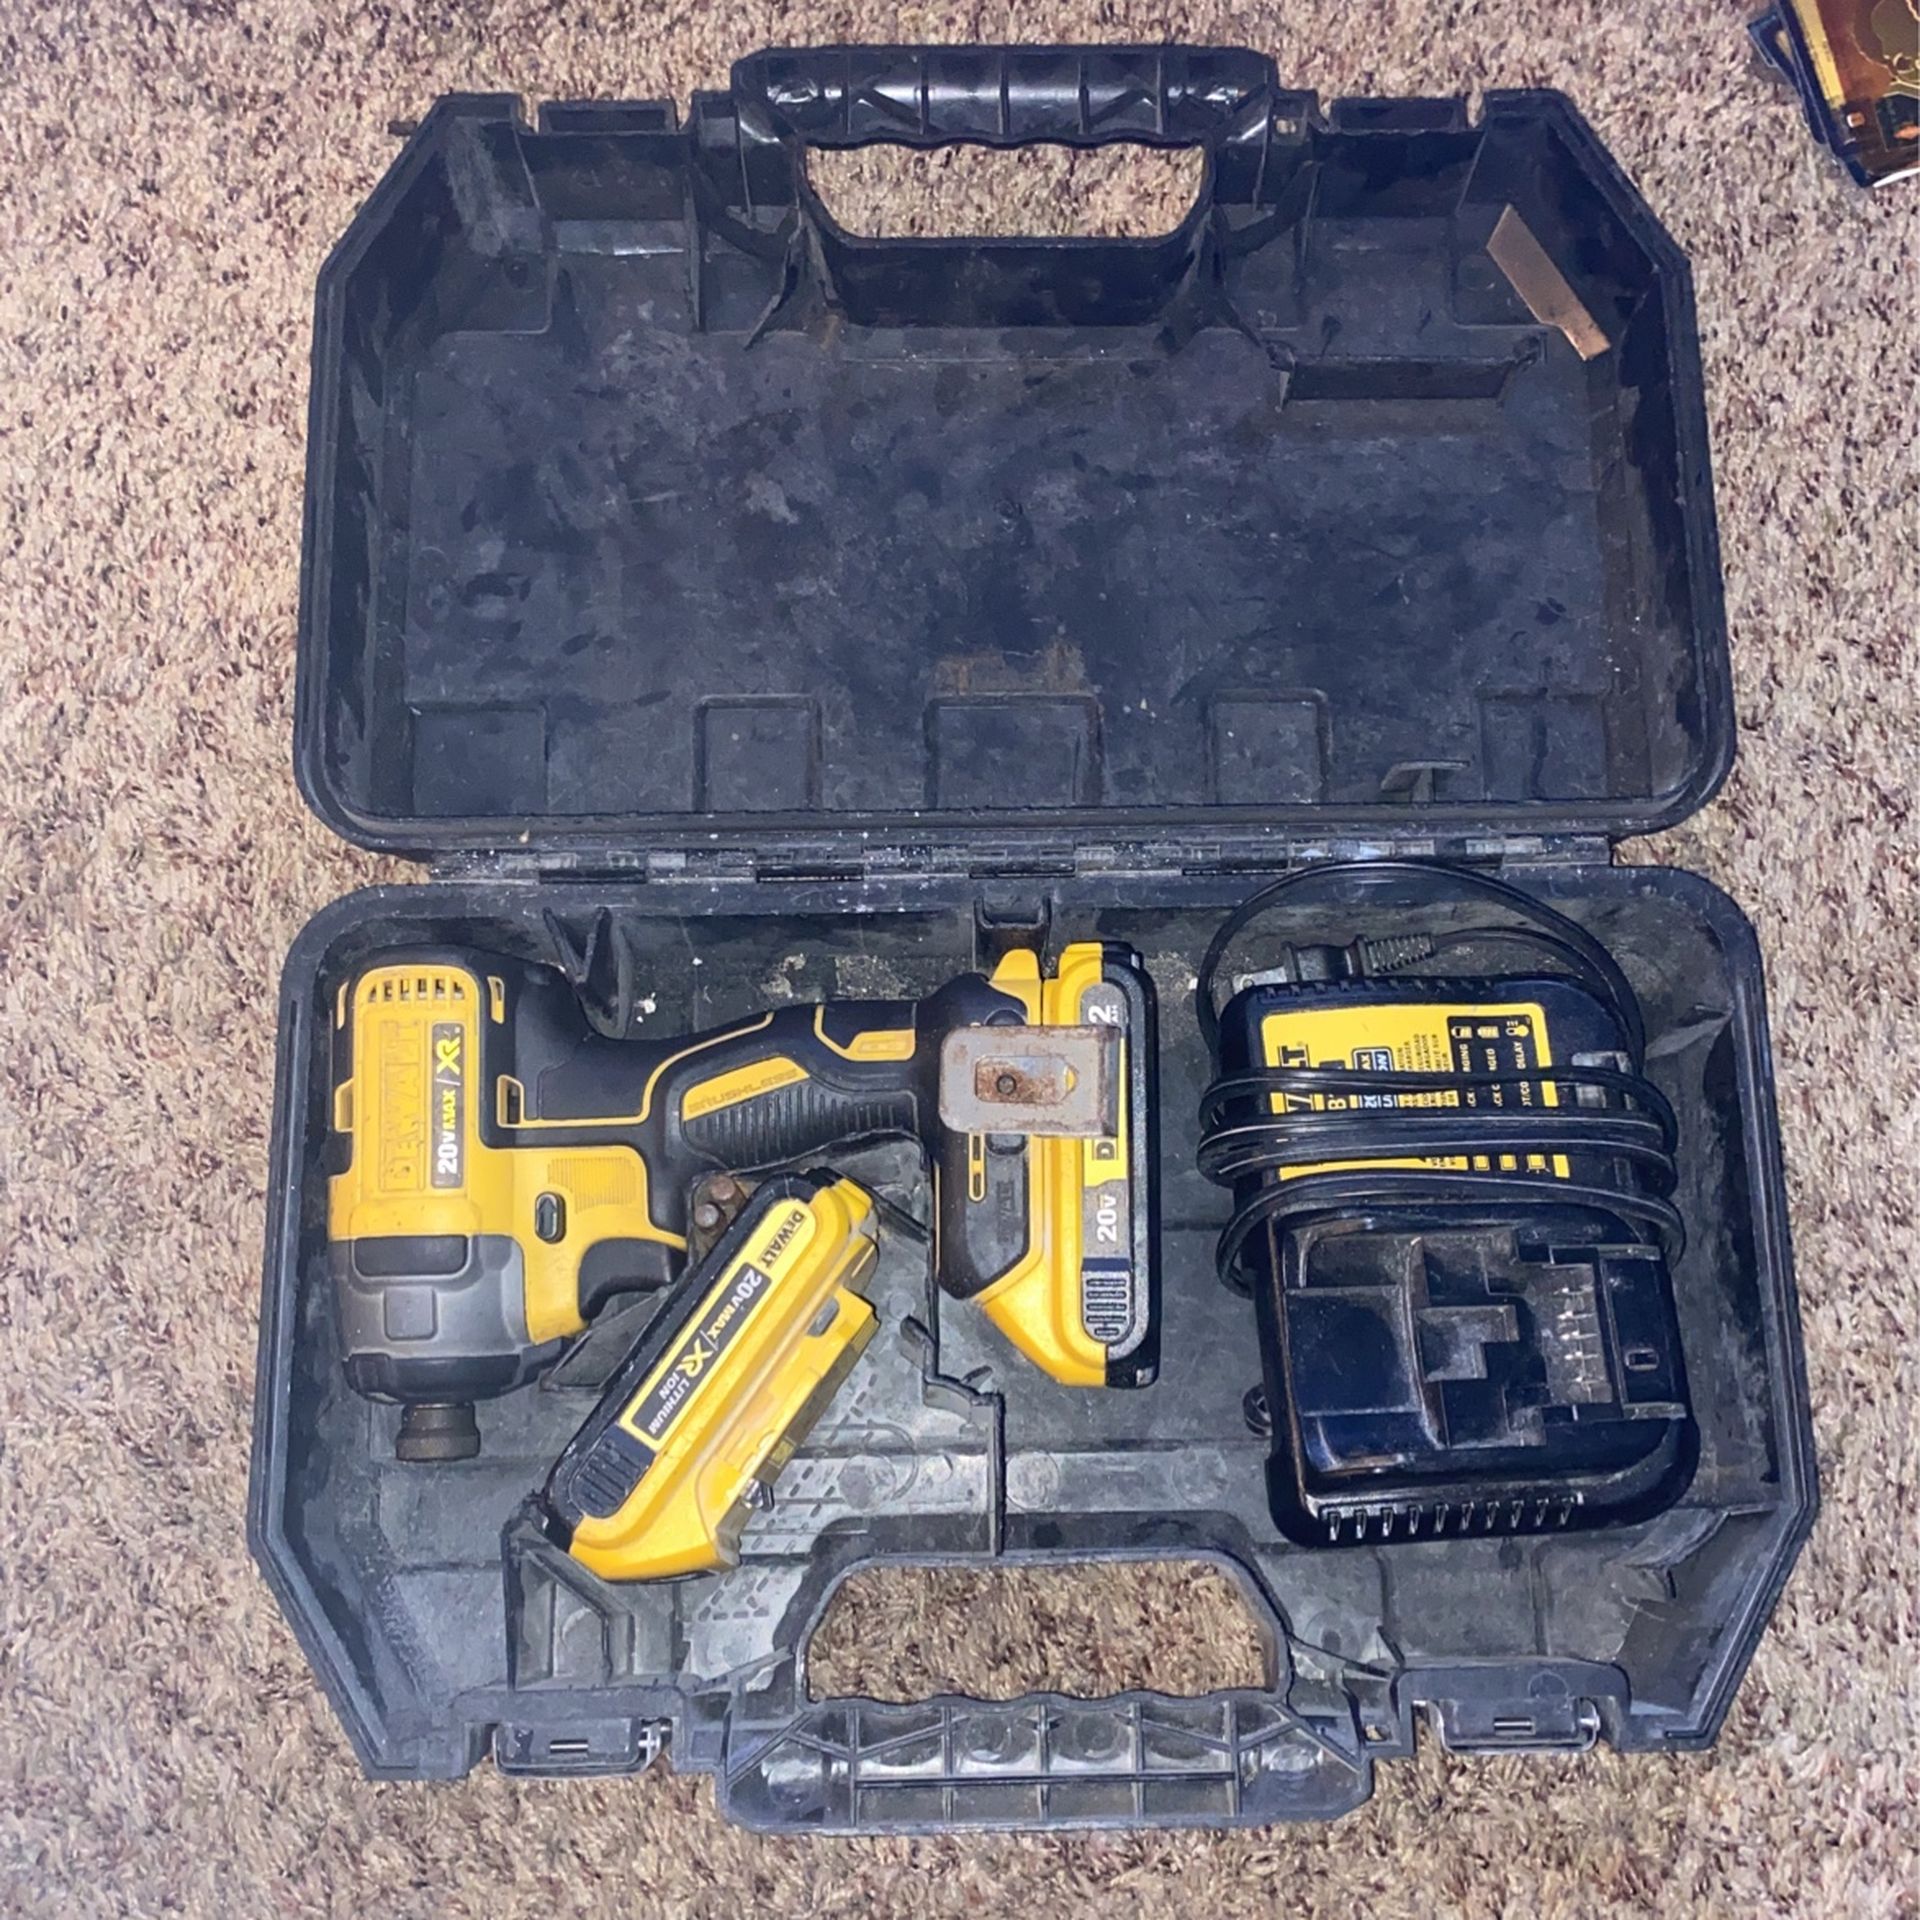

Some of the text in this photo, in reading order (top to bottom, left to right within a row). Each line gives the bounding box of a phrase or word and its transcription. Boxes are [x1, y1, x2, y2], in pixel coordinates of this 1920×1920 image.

[1088, 1004, 1111, 1024] 2
[436, 1036, 461, 1076] XR
[1360, 1054, 1372, 1071] AX
[1459, 1043, 1472, 1073] RGING
[1513, 1041, 1526, 1070] DELAY
[383, 1022, 420, 1189] DEWALT
[760, 1209, 805, 1268] DEWALT
[675, 1337, 715, 1378] XR
[658, 1371, 680, 1400] ION
[647, 1378, 690, 1435] LITHIUM
